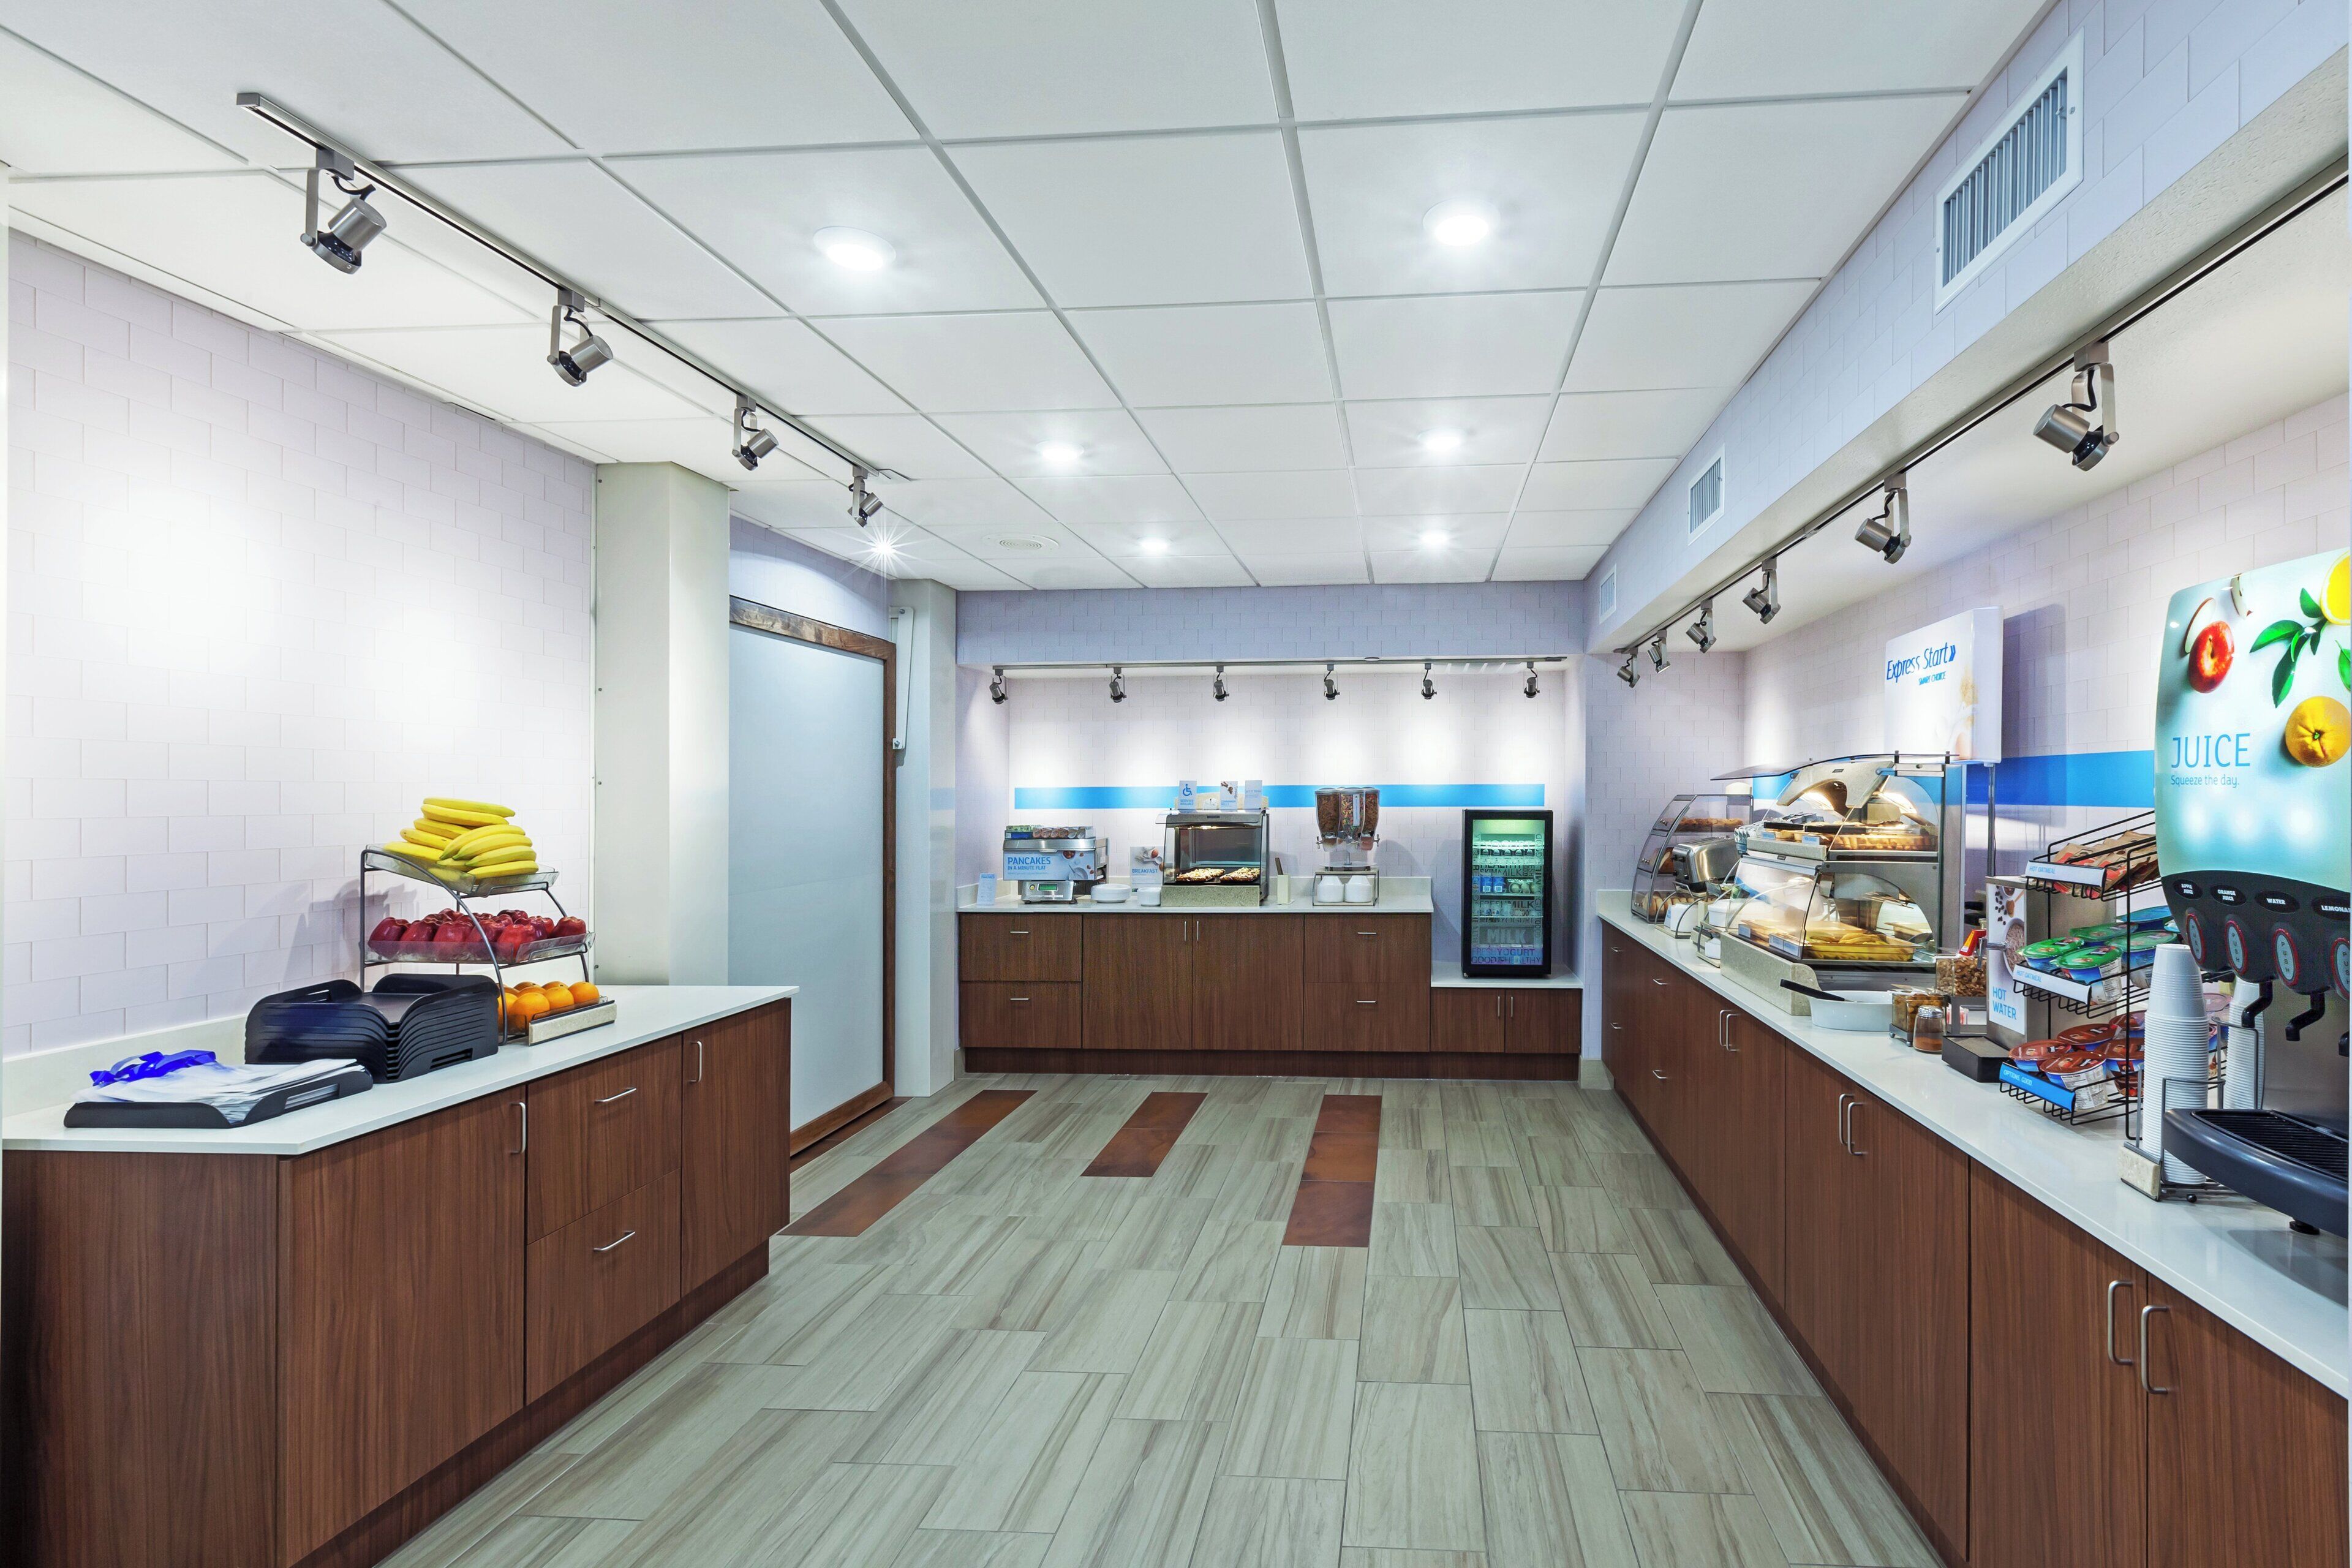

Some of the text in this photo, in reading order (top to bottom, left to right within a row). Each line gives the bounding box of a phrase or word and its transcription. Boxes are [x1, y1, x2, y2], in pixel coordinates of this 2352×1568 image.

[1887, 642, 1948, 683] Express Start
[2171, 733, 2250, 769] JUICE
[2171, 774, 2240, 788] Squeeze the day.
[1007, 856, 1051, 865] PANCAKES
[1487, 929, 1527, 944] MILK
[2281, 941, 2290, 973] PUSH
[1992, 986, 2007, 1001] HOT
[1992, 1001, 2017, 1020] WATER
